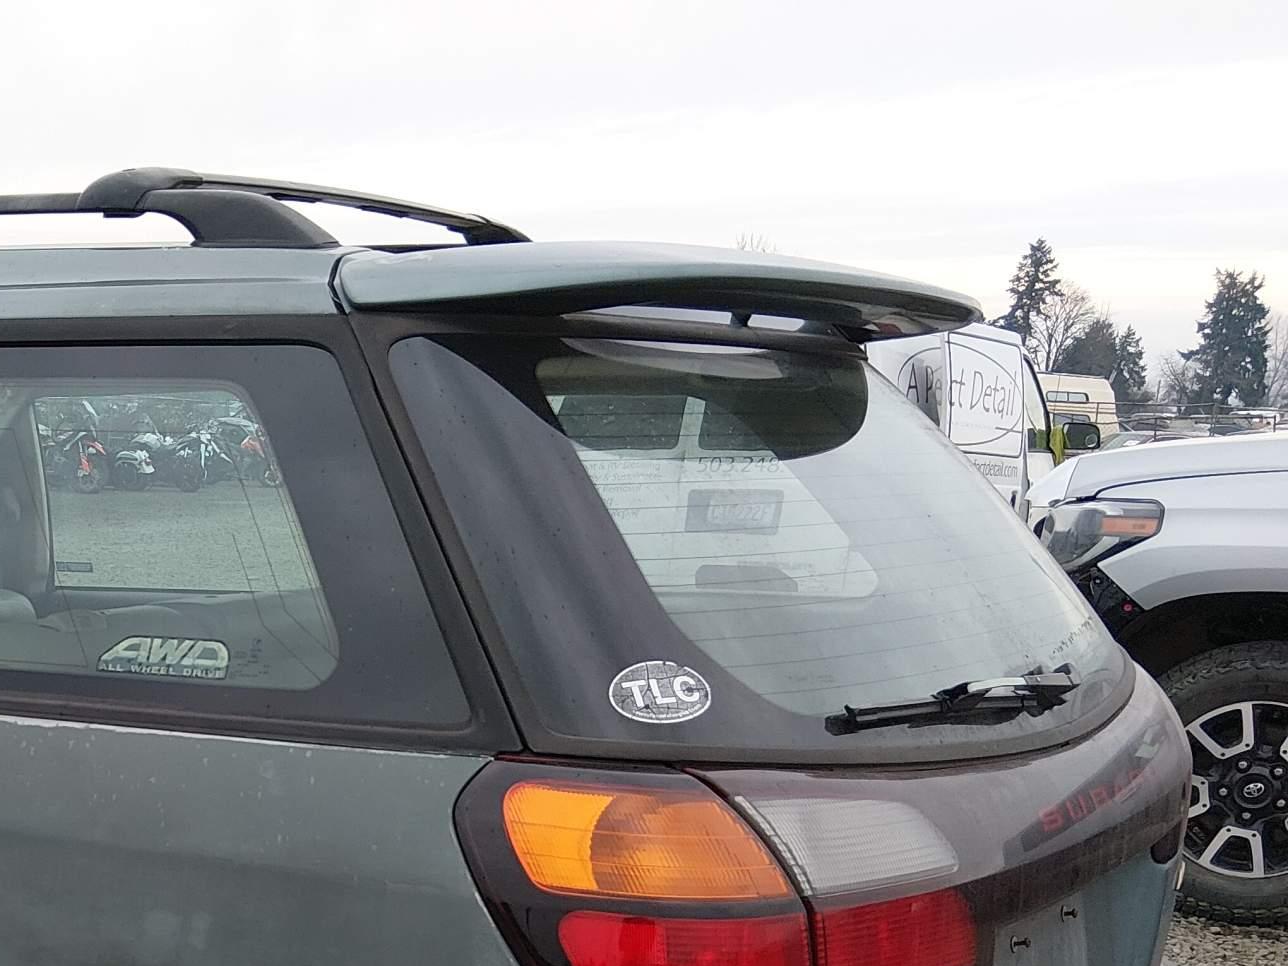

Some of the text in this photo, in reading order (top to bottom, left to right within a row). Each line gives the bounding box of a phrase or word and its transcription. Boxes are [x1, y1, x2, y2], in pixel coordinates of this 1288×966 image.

[905, 361, 920, 403] A
[970, 370, 1017, 419] Detail
[100, 636, 229, 668] AWD
[99, 663, 226, 679] ALL WHEEL DRIVE
[621, 675, 700, 707] TLC
